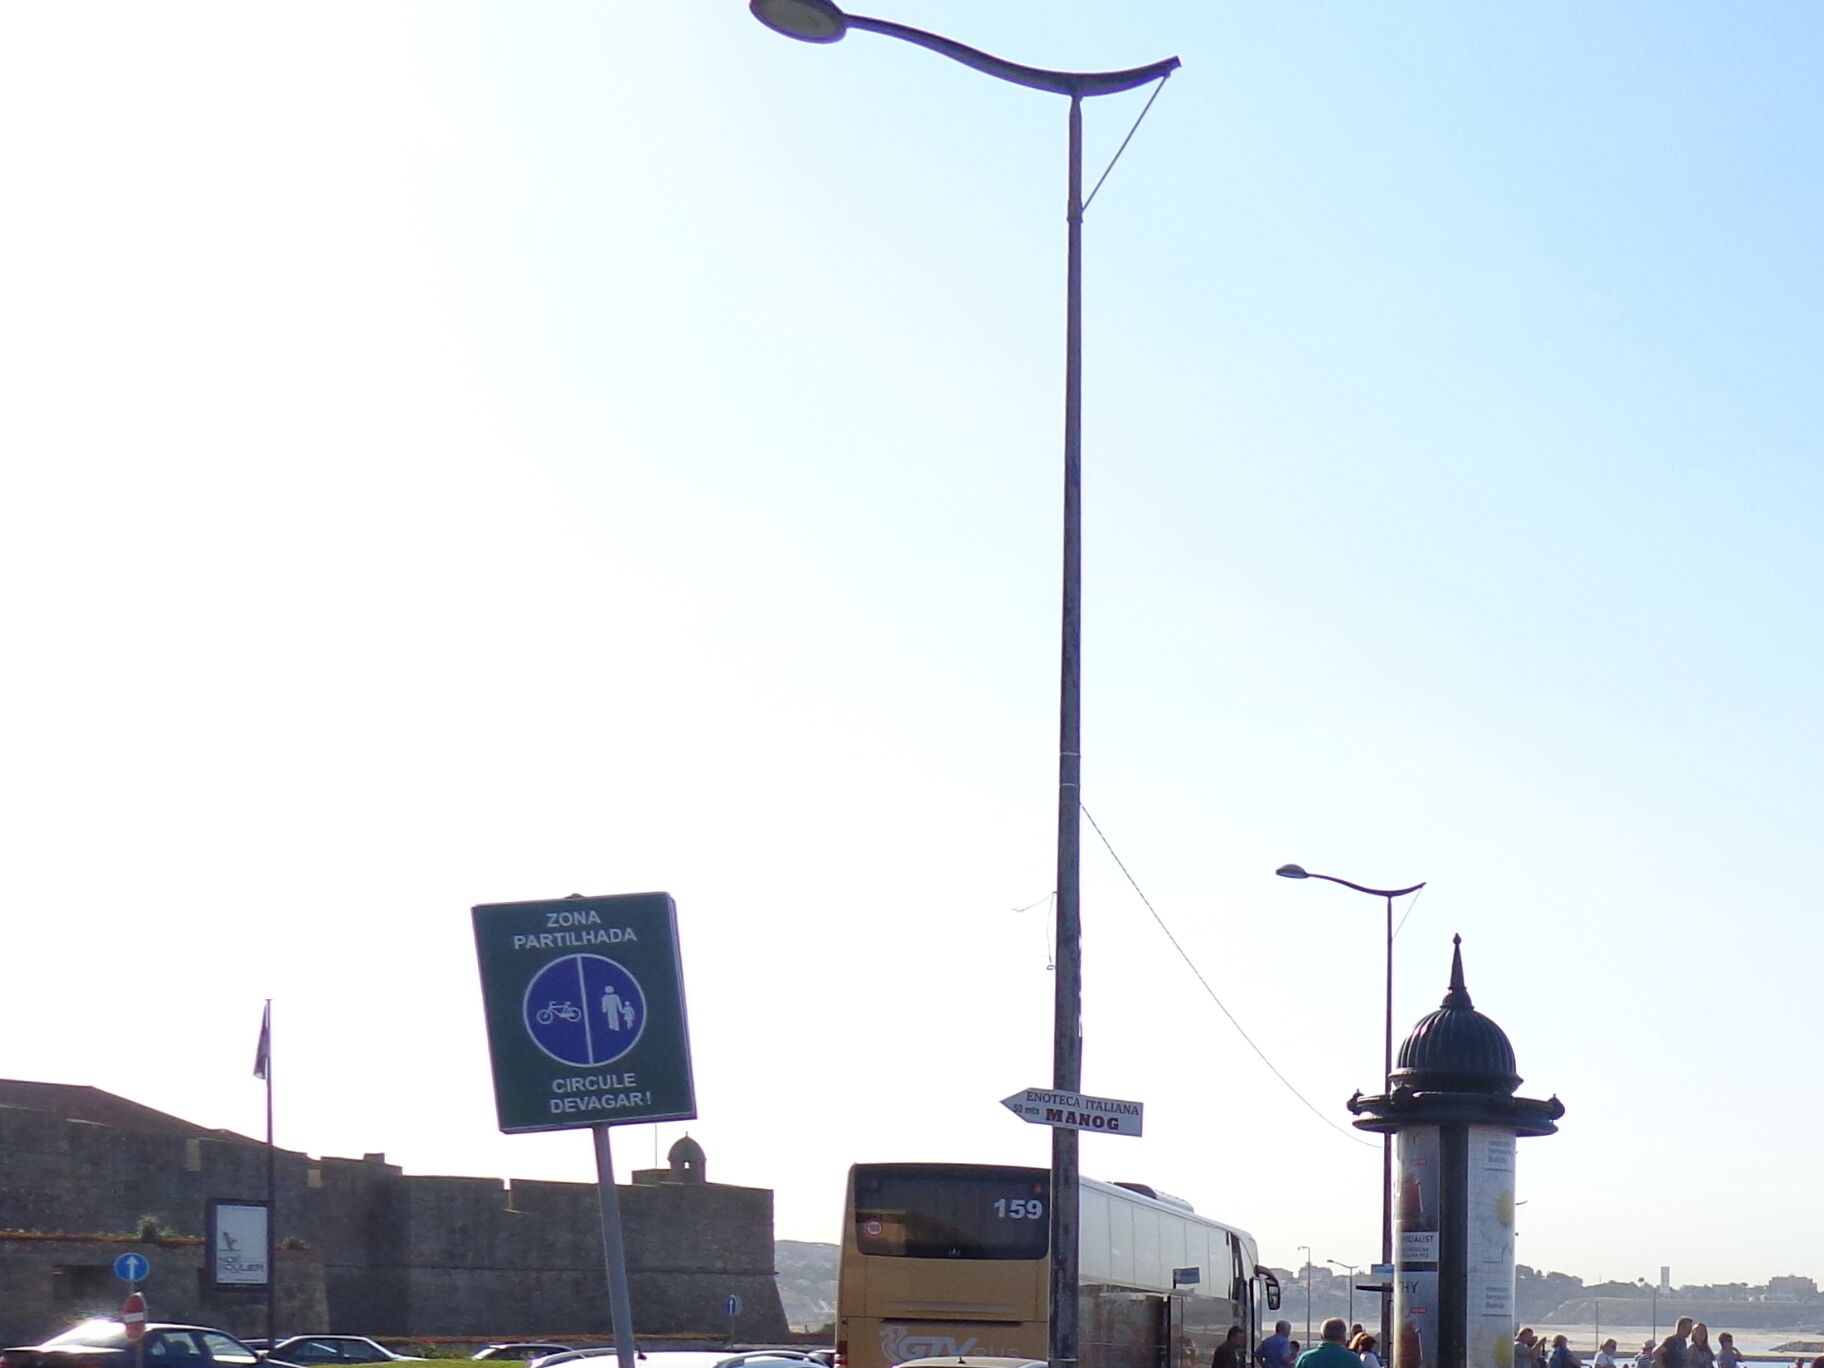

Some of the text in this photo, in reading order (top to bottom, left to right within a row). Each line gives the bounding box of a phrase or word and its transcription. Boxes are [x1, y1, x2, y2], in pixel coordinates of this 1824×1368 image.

[546, 910, 601, 928] ZONA
[513, 927, 638, 950] PARTILHADA
[551, 1072, 637, 1094] CIRCULE
[1026, 1091, 1139, 1116] ENOTECA ITALIANA
[1045, 1108, 1120, 1130] MANOG
[994, 1198, 1043, 1219] 159
[898, 1335, 978, 1360] GTV
